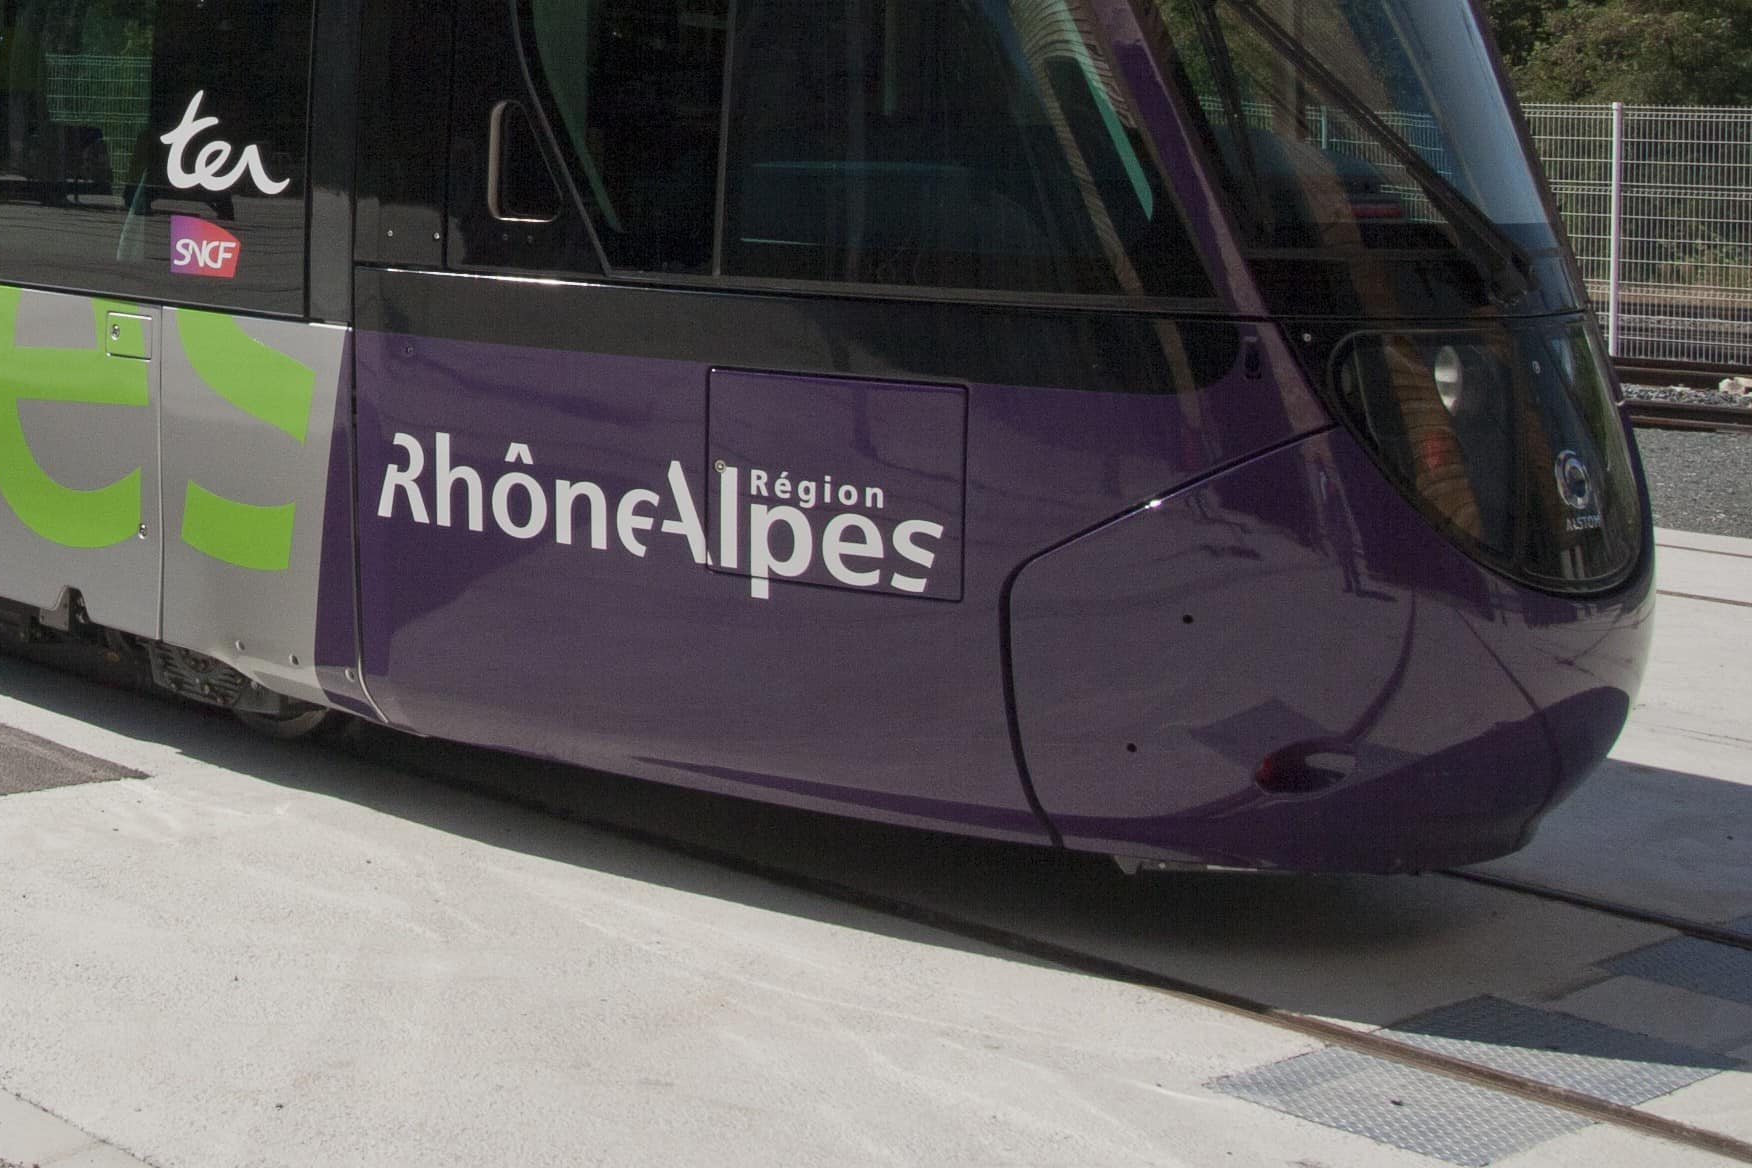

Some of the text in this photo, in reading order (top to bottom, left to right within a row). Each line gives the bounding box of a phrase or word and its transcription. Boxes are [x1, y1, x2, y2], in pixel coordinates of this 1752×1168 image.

[160, 89, 290, 195] ter
[173, 238, 236, 269] SNCF
[750, 469, 884, 509] Région
